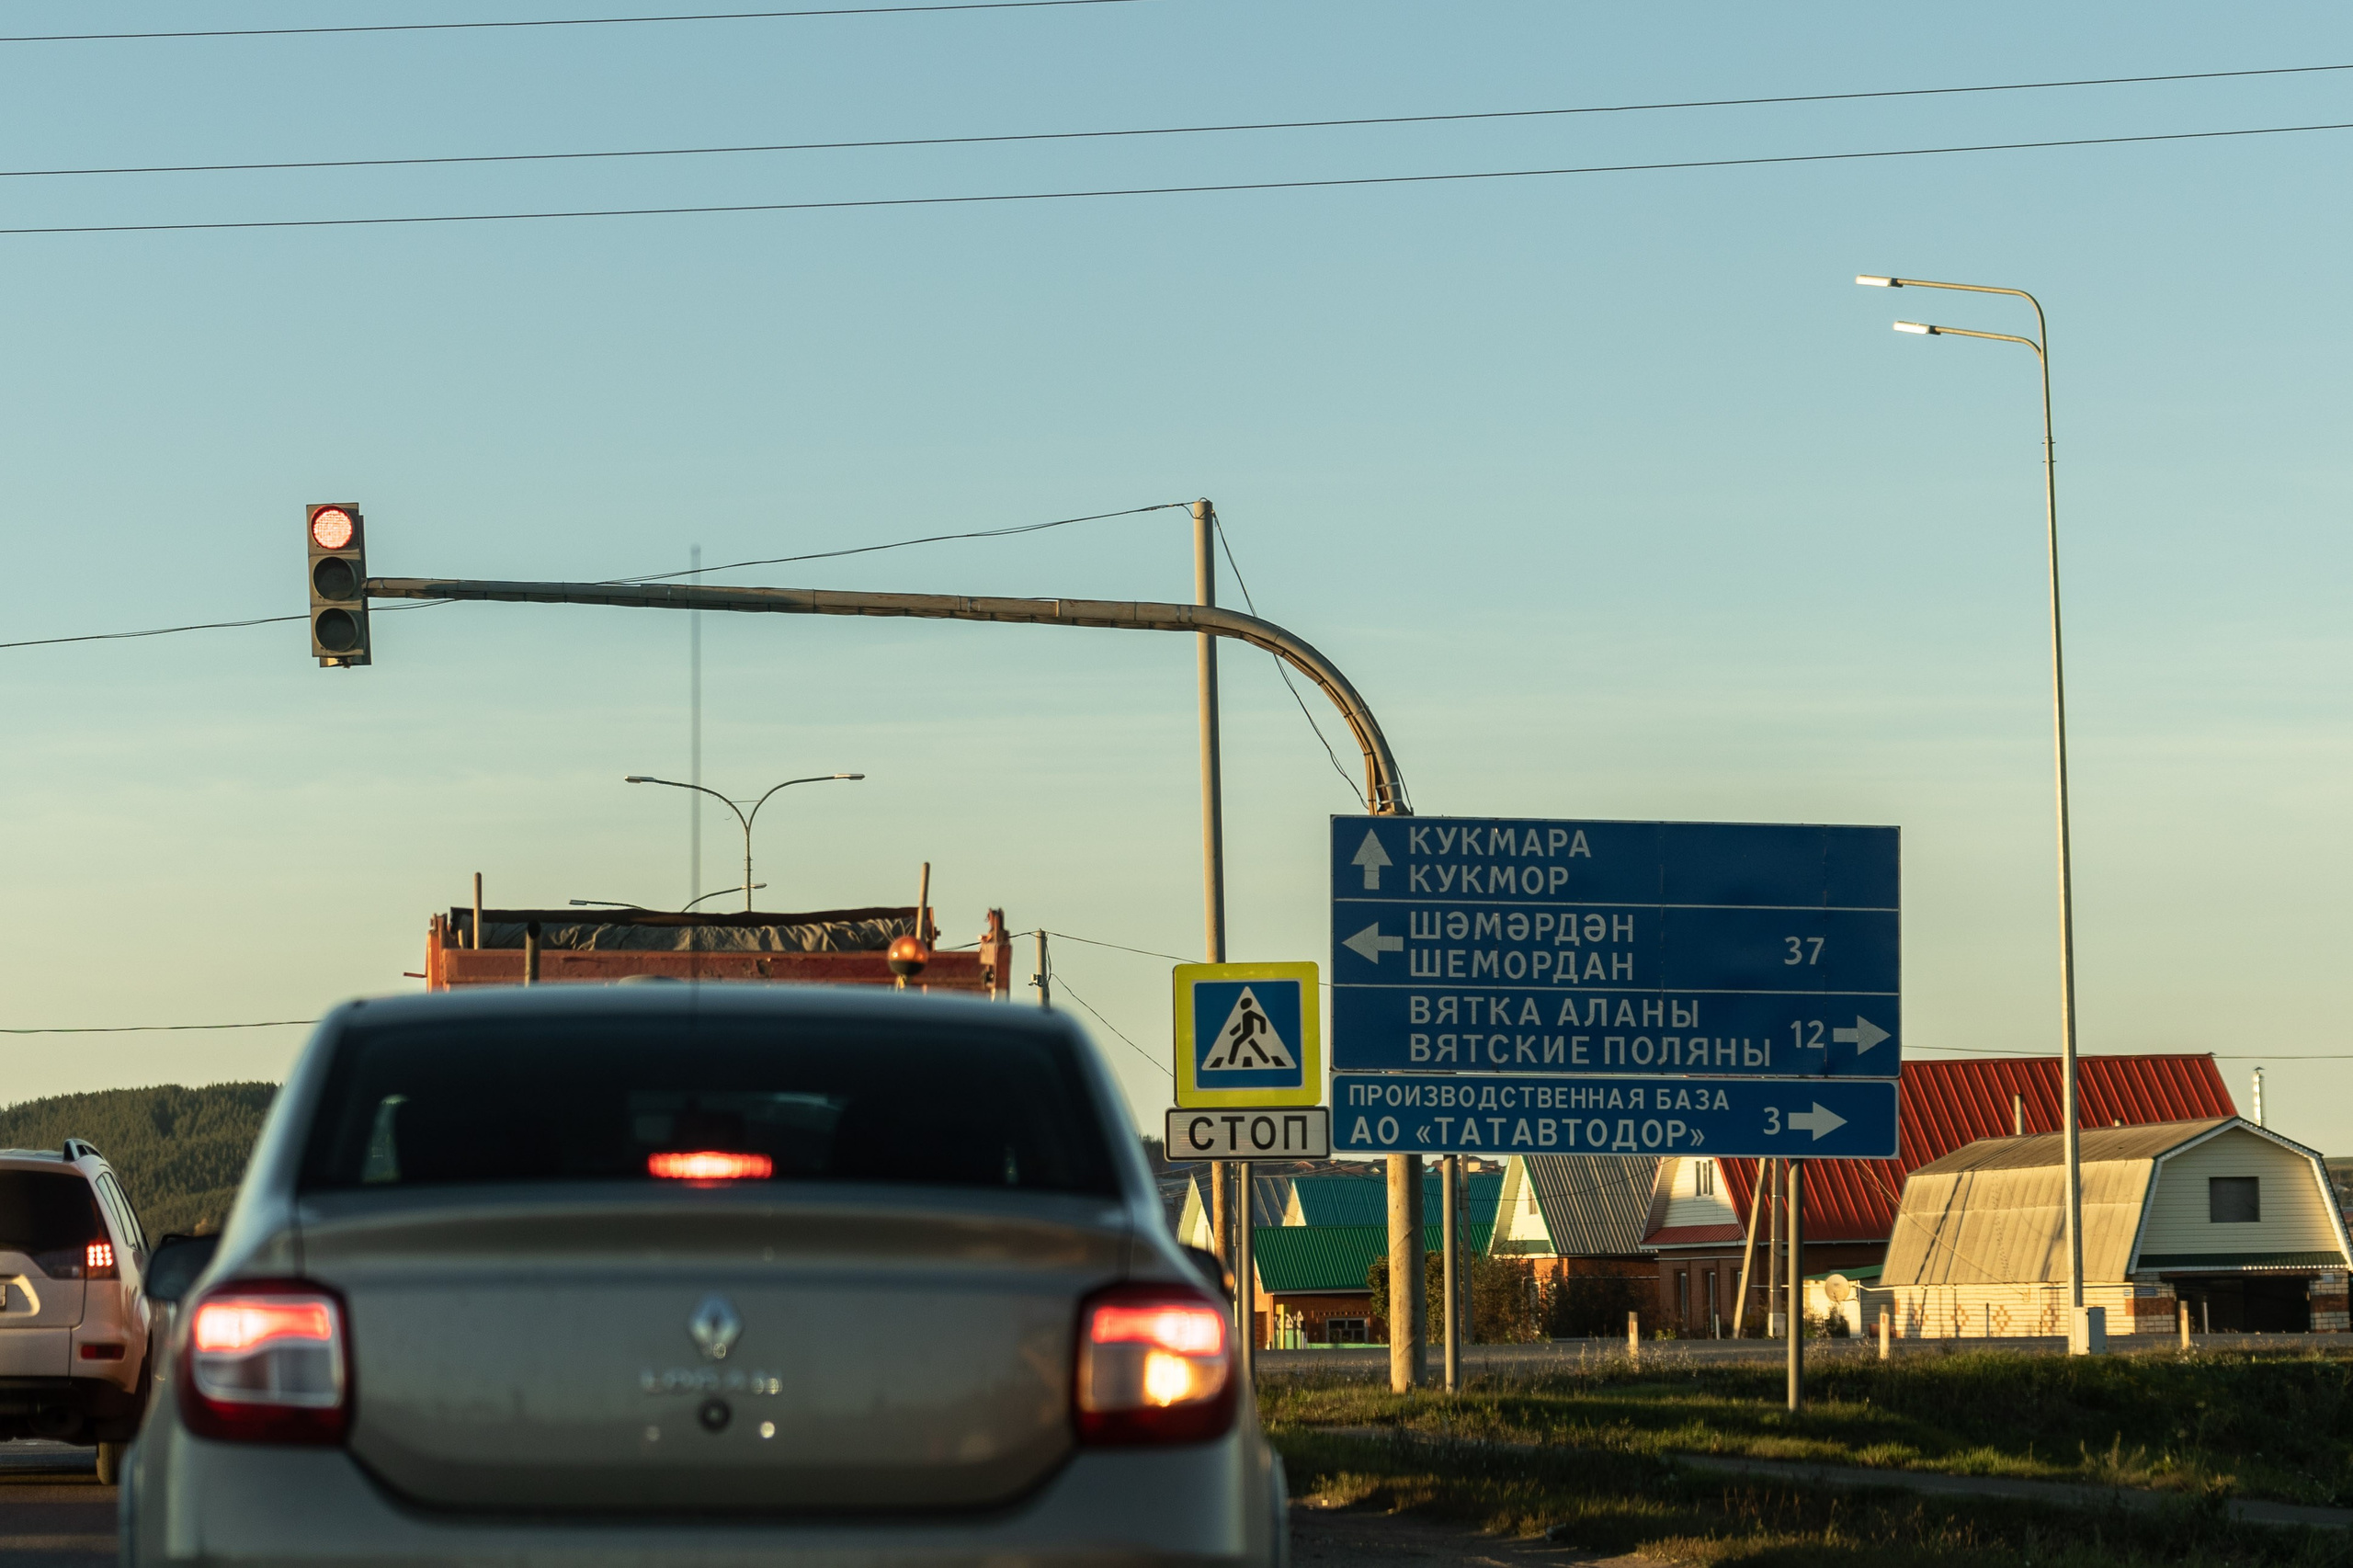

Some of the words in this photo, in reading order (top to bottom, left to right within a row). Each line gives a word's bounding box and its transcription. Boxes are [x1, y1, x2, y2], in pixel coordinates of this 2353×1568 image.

[1410, 826, 1591, 858] КУКМАРА
[1410, 864, 1569, 895] КУКМОР
[1410, 911, 1633, 947] ШӘМӘРДӘН
[1410, 949, 1633, 984] ШЕМОРДАН
[1784, 936, 1825, 966] 37
[1410, 995, 1541, 1026] ВЯТКА
[1558, 998, 1699, 1028] АЛАНЫ
[1410, 1033, 1590, 1064] ВЯТСКИЕ
[1604, 1036, 1770, 1067] ПОЛЯНЫ
[1790, 1019, 1825, 1050] 12
[1349, 1084, 1644, 1111] ПРОИЗВОДСТВЕННАЯ
[1656, 1088, 1730, 1111] БАЗА
[1188, 1115, 1308, 1151] СТОП
[1349, 1116, 1400, 1145] АО
[1415, 1117, 1706, 1152] «ТАТАВТОДОР»
[1763, 1107, 1781, 1136] 3
